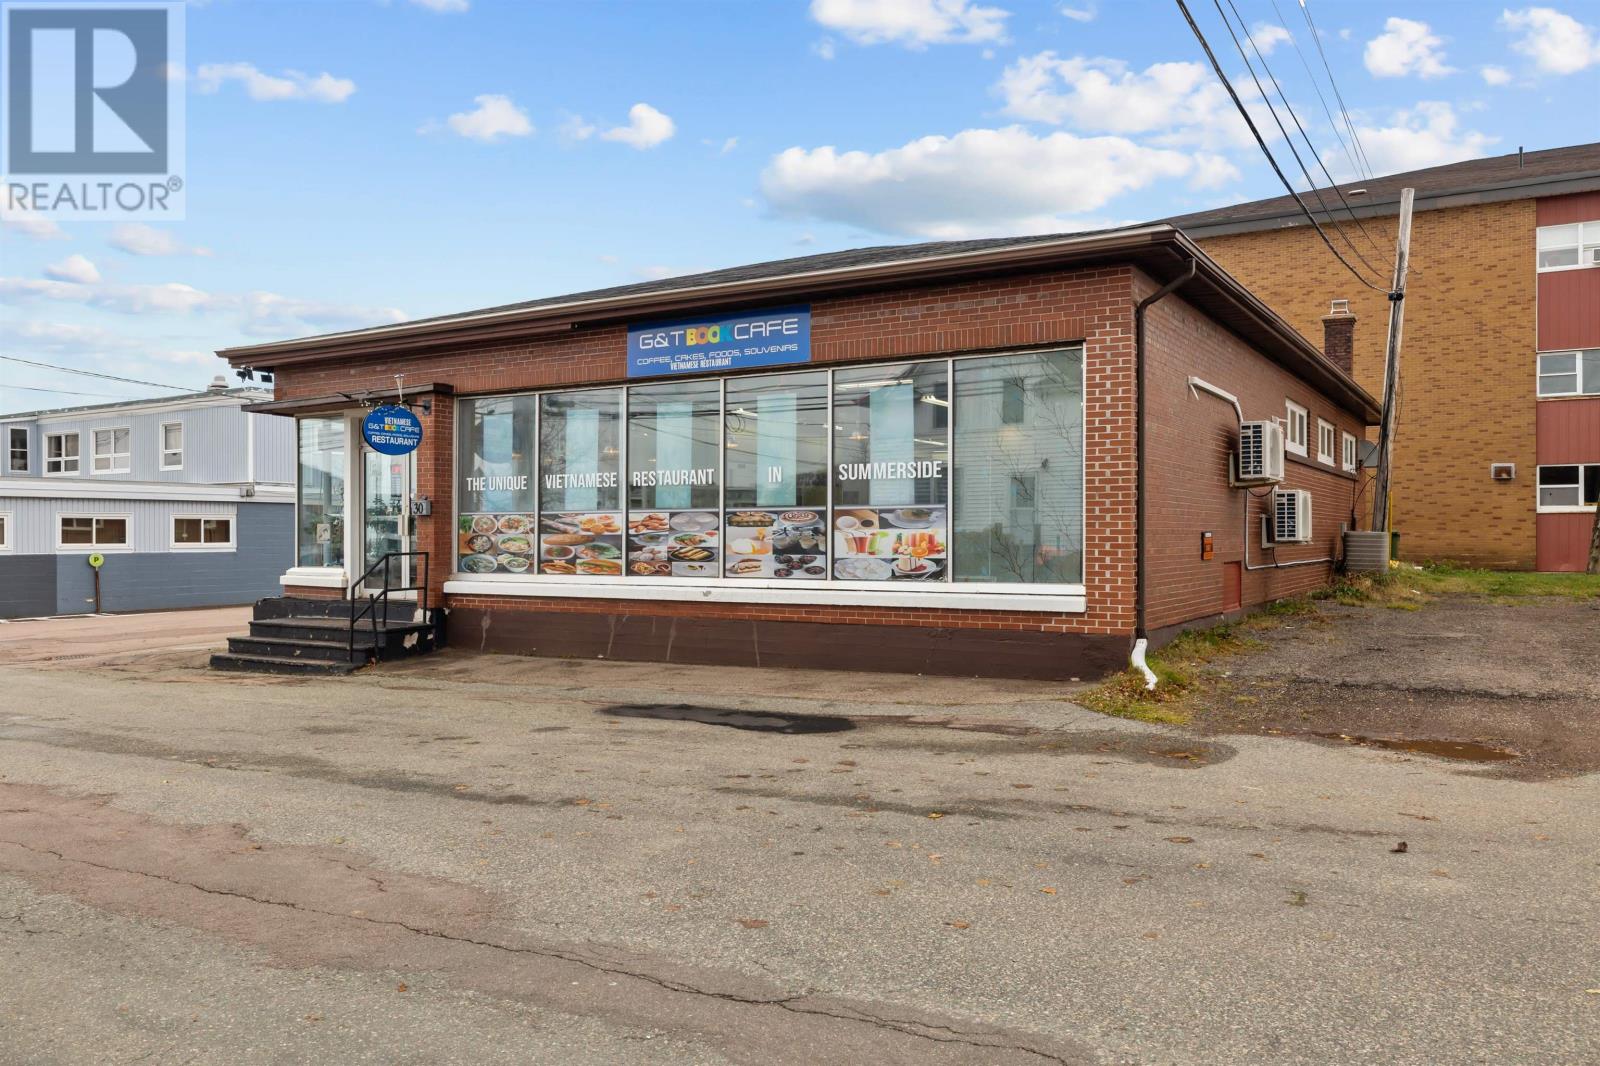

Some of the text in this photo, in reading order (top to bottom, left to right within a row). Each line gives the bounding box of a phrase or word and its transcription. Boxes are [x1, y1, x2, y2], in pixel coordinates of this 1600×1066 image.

[639, 330, 684, 349] G&T
[734, 318, 799, 340] CAFE
[744, 344, 798, 356] SOUVENIRS
[371, 435, 418, 446] RESTAURANT
[466, 460, 943, 491] THE UNIQUE VIETNAMESE RESTAURANT IN SUMMERSIDE
[413, 502, 424, 515] 30
